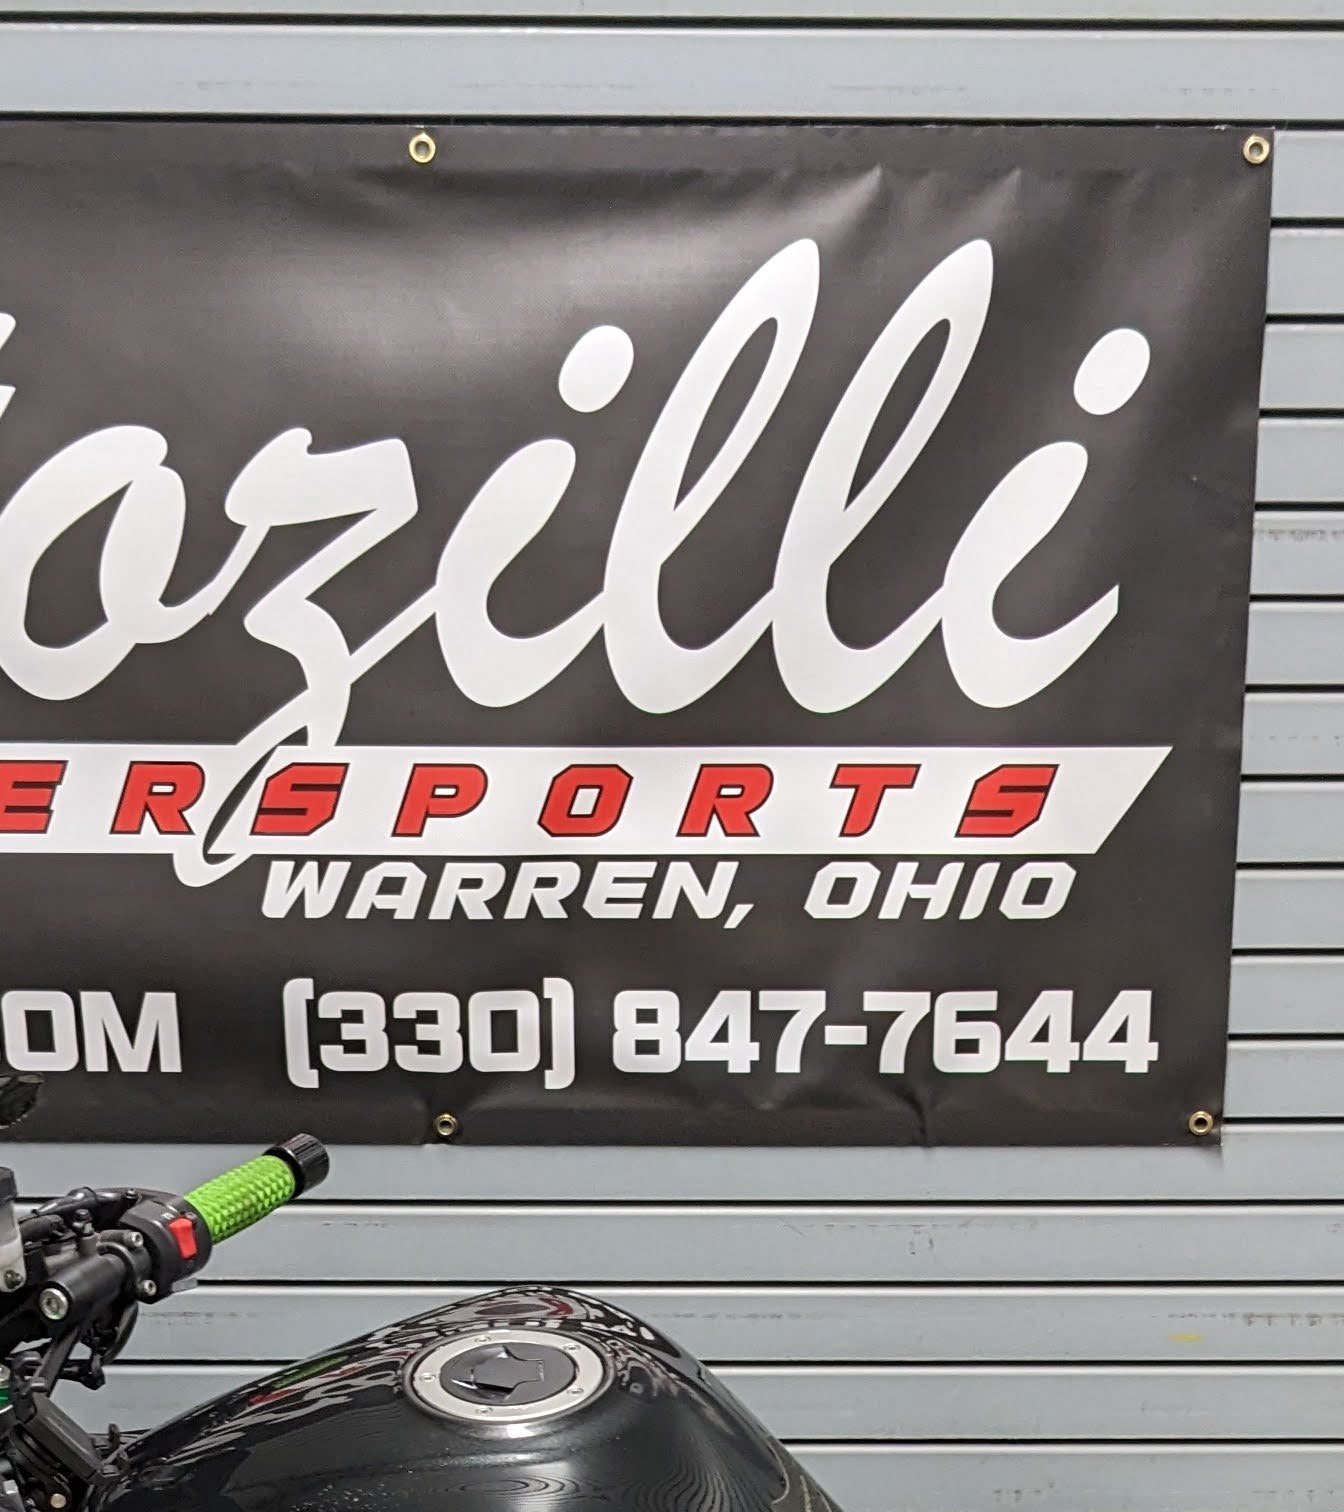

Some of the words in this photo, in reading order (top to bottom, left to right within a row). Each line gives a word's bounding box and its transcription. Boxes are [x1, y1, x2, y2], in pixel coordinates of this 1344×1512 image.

[260, 860, 754, 930] WARREN,
[803, 860, 1078, 921] OHIO
[282, 977, 576, 1090] (330)
[612, 989, 1159, 1074] 847-7644
